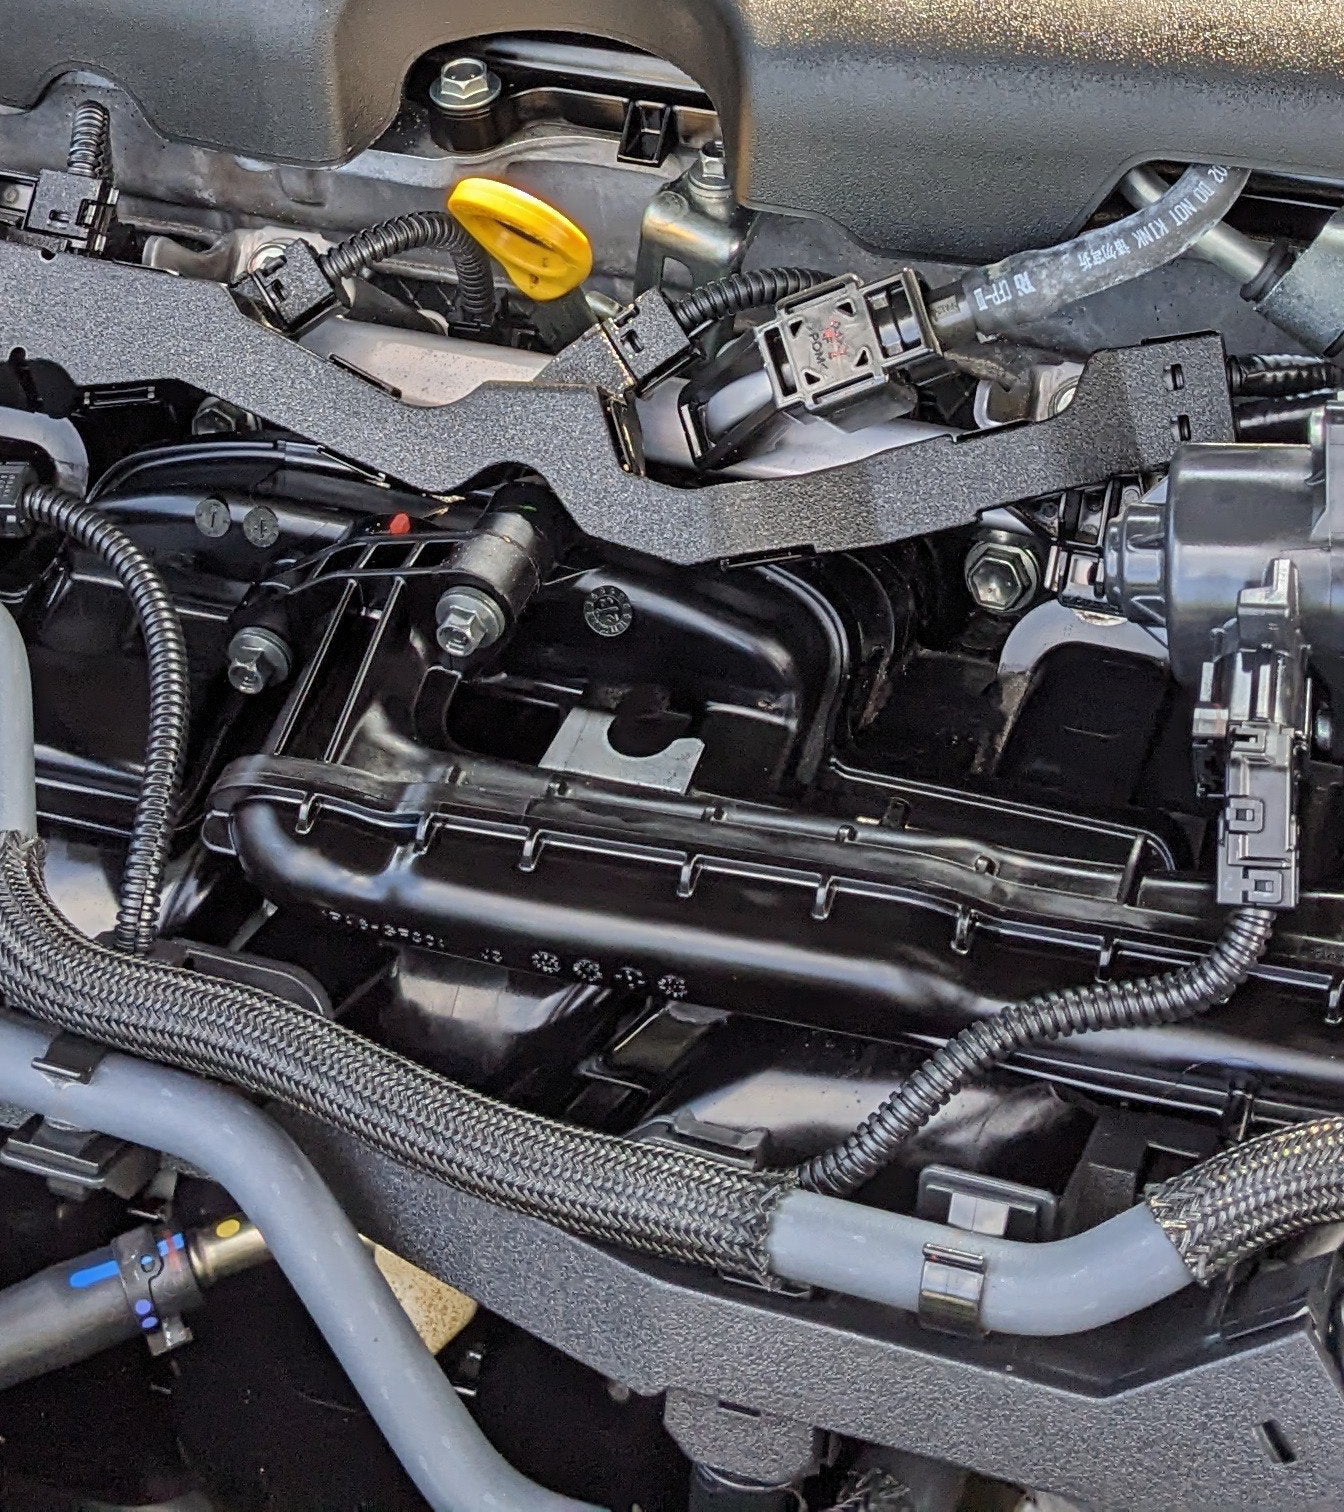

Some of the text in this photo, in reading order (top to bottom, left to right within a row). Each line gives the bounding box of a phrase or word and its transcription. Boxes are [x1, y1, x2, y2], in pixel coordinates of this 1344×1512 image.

[1193, 180, 1215, 204] DO
[1168, 197, 1198, 227] NOT
[1131, 217, 1170, 249] KINK
